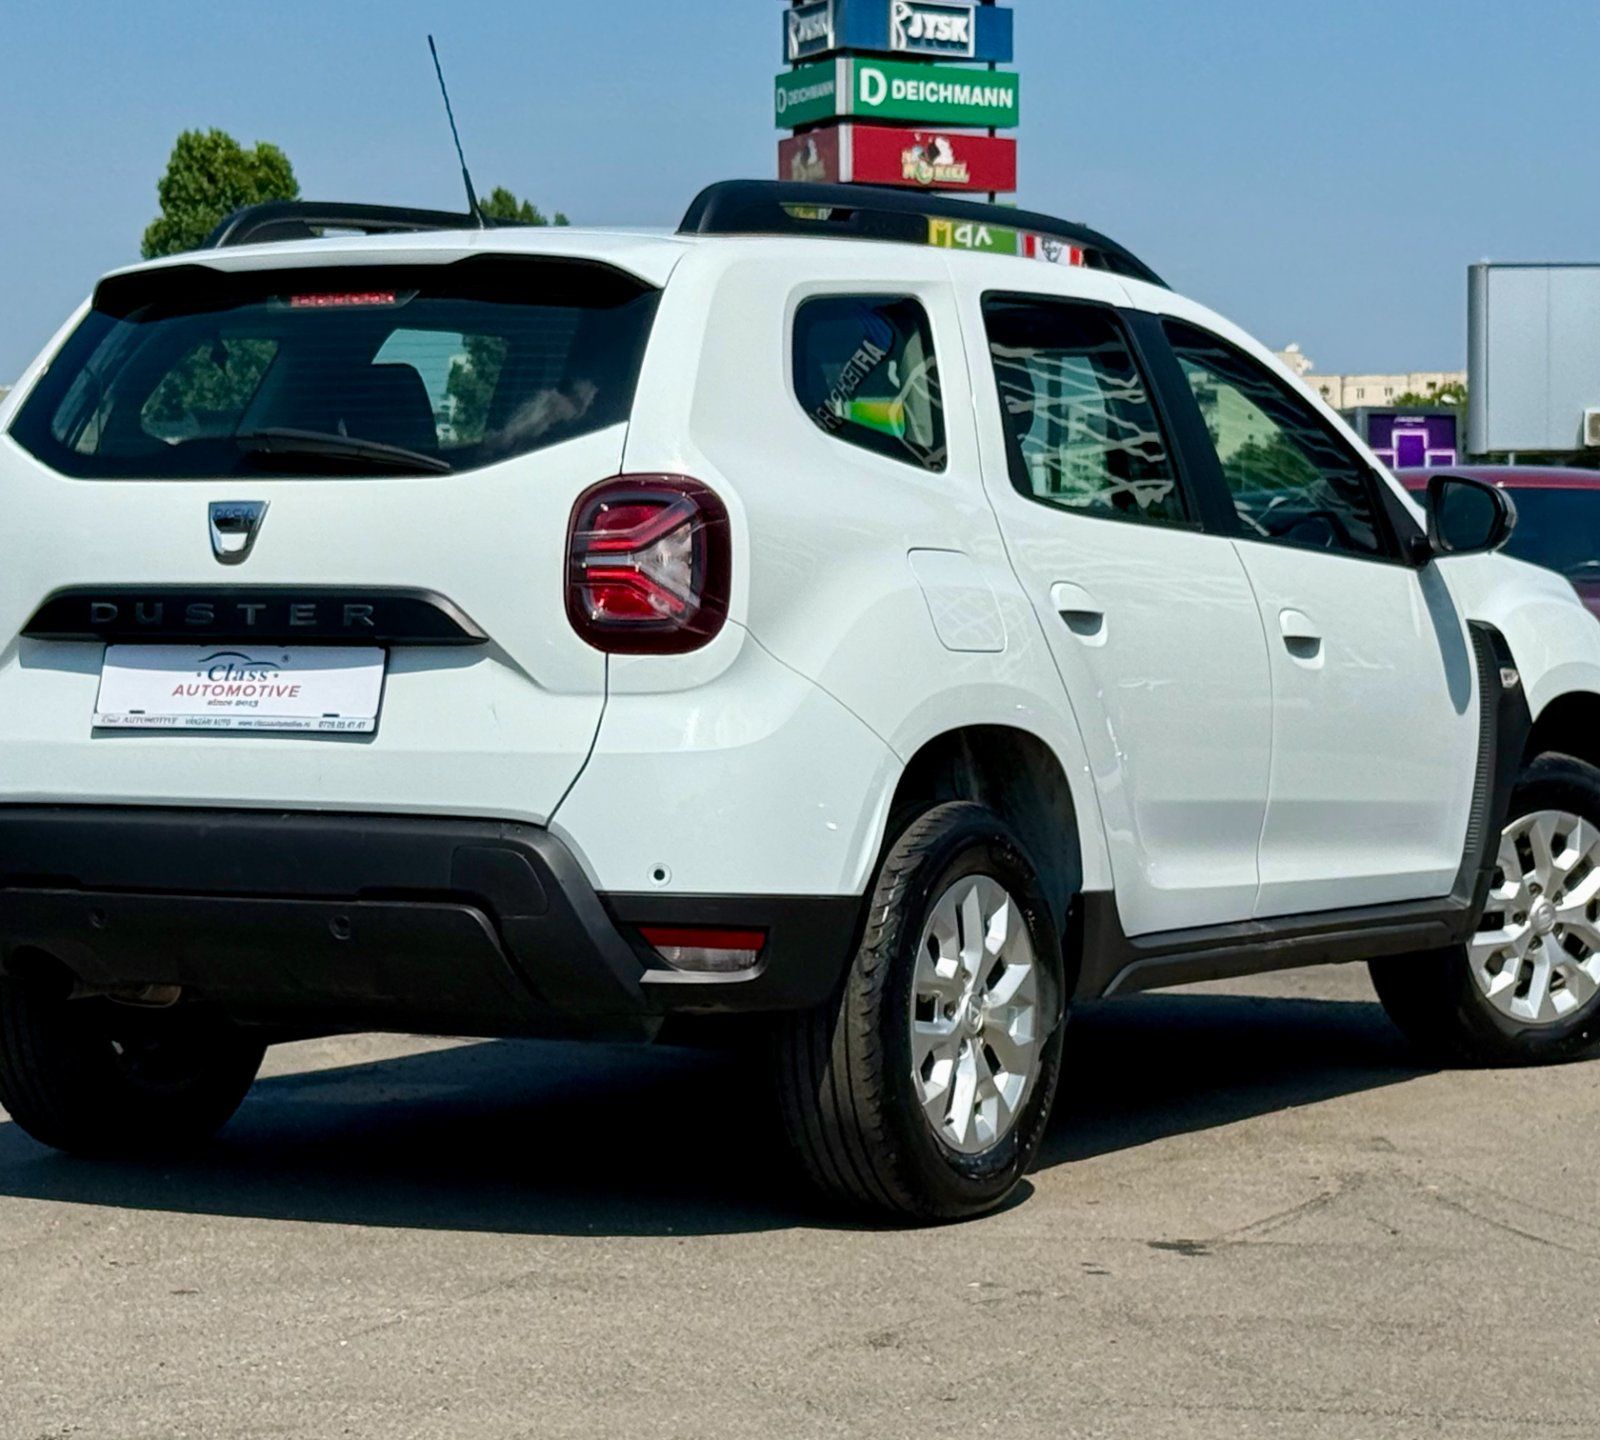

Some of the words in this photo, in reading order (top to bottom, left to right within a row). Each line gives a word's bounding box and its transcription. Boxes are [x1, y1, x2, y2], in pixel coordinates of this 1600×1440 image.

[908, 12, 969, 43] JYSK
[891, 78, 1014, 109] DEICHMANN
[90, 602, 375, 627] DUSTER
[207, 663, 269, 683] Class
[171, 684, 302, 699] AUTOMOTIVE
